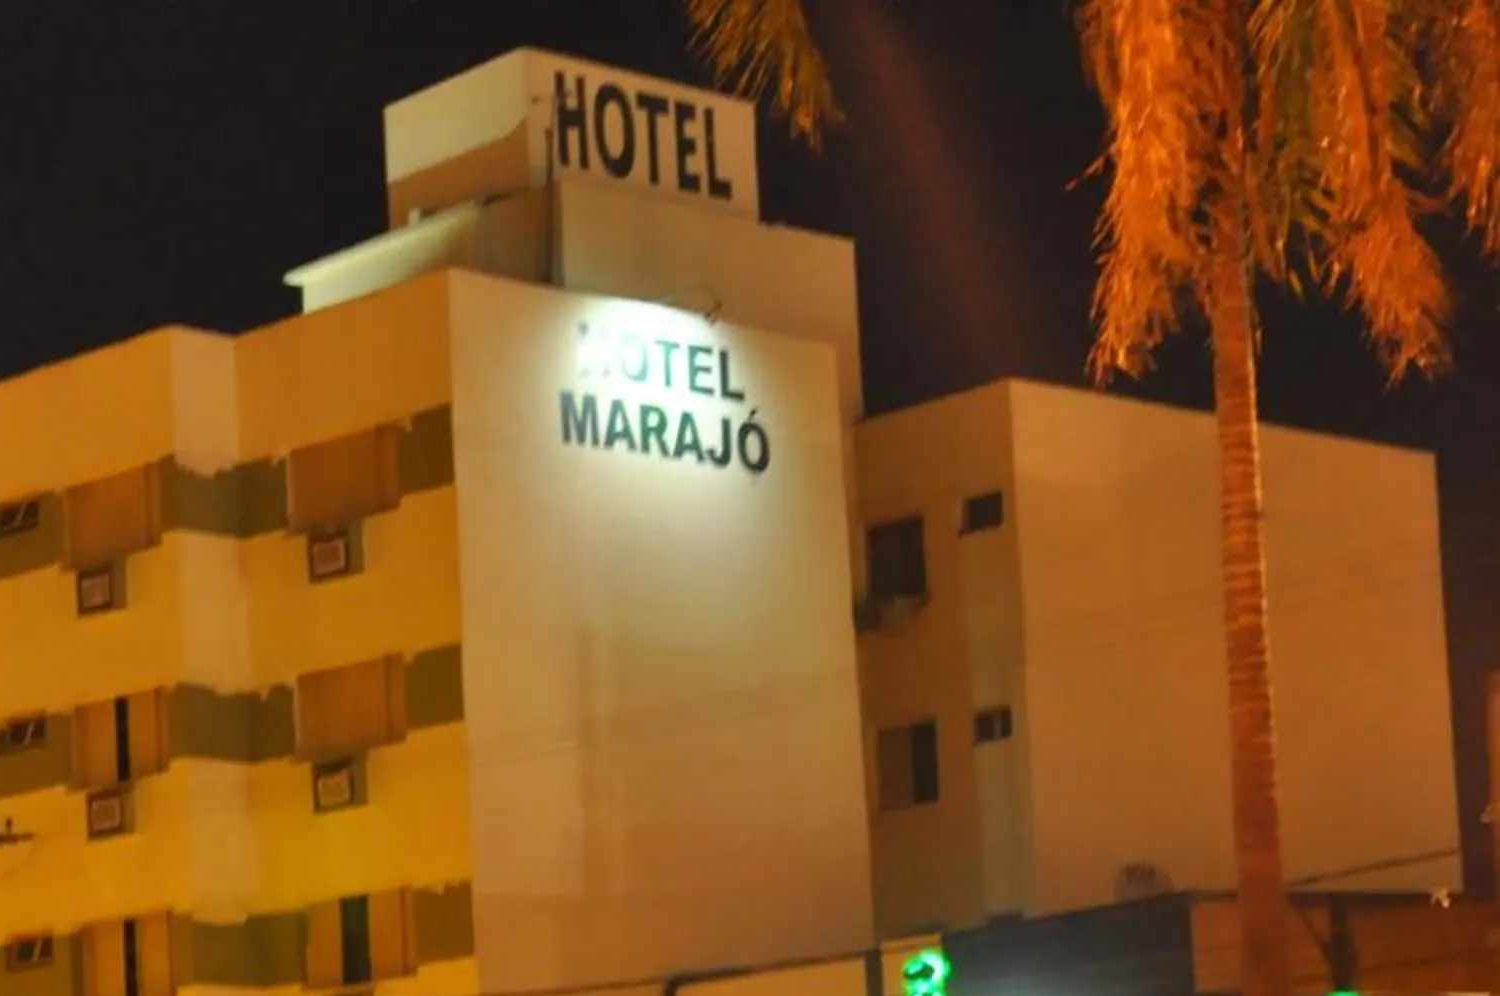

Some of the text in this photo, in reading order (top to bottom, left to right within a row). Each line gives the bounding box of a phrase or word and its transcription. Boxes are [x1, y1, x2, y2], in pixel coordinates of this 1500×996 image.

[554, 70, 733, 201] HOTEL
[579, 322, 746, 403] OTEL
[559, 390, 771, 474] MARAJÓ
